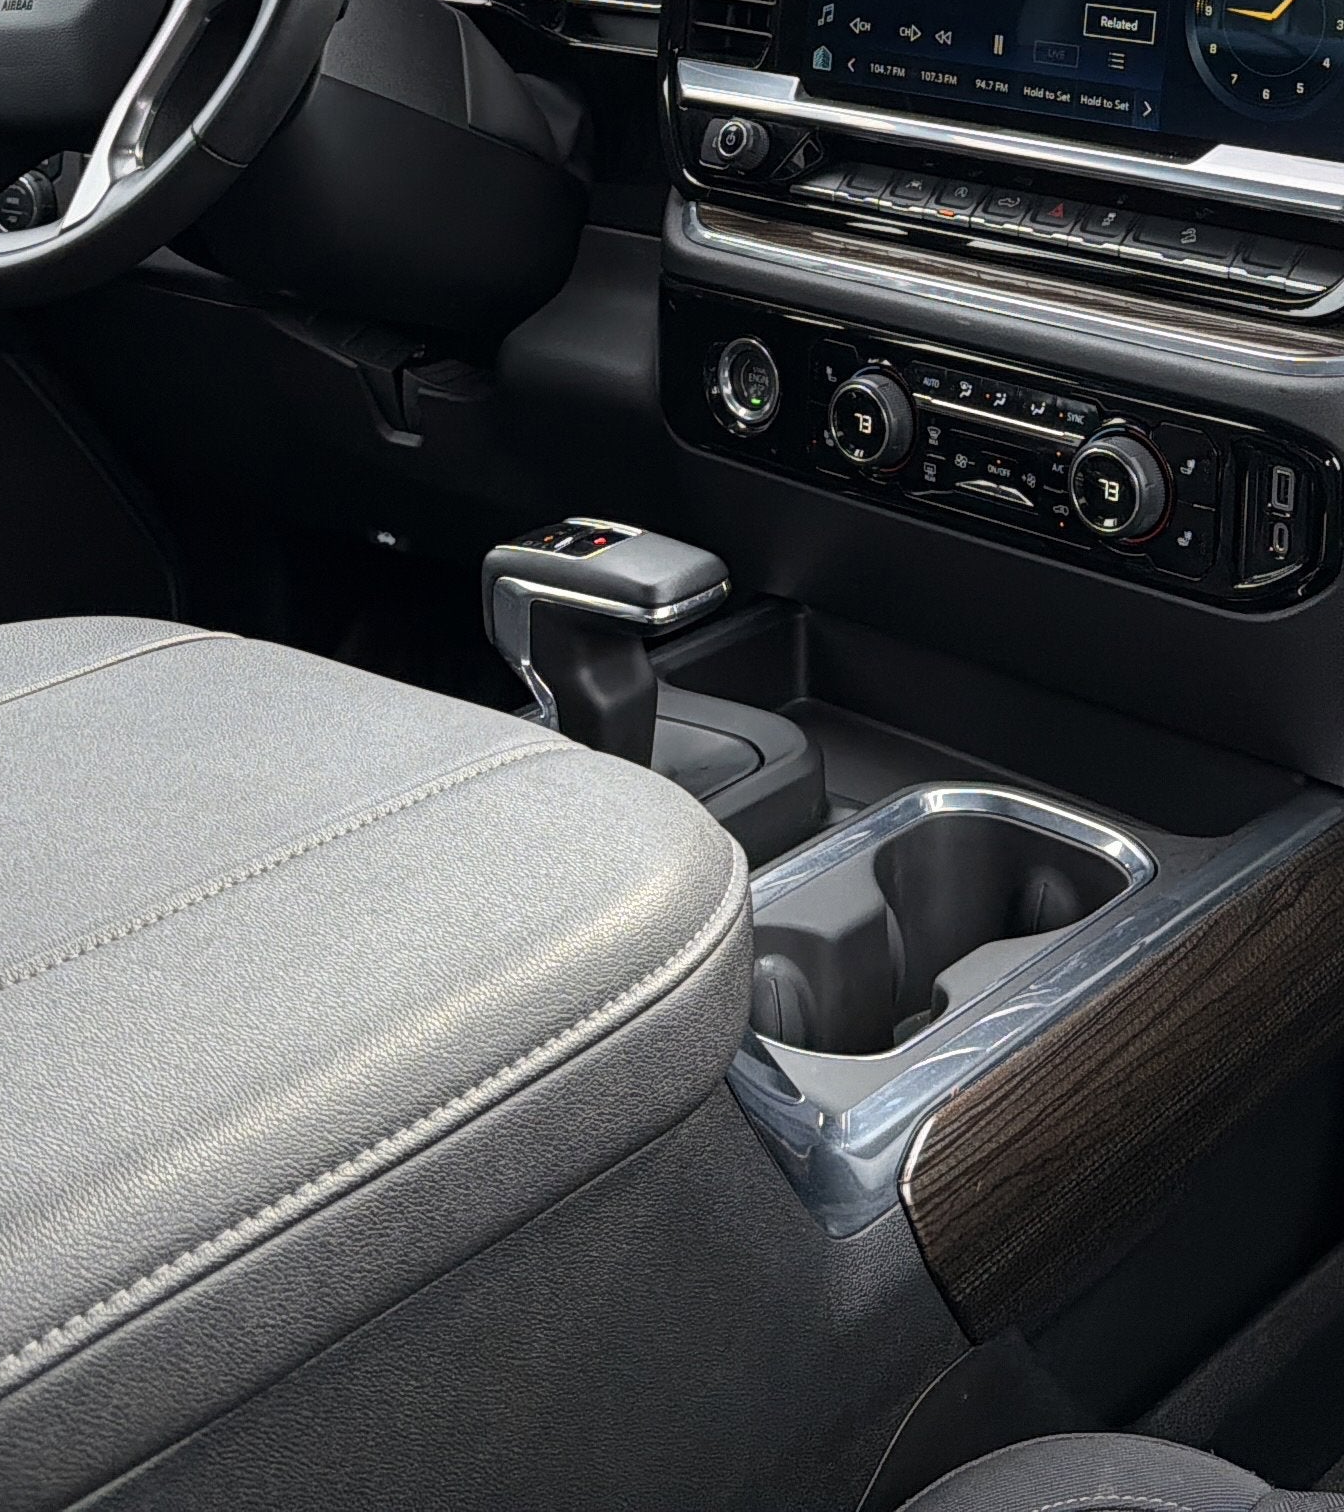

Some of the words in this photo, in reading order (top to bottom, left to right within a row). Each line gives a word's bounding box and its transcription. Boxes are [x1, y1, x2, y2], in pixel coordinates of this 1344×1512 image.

[0, 0, 34, 12] AIRBAG
[1205, 5, 1213, 17] 9
[860, 21, 871, 32] CH
[1100, 15, 1138, 31] Related
[1336, 19, 1344, 31] 3
[899, 26, 911, 37] CH
[1209, 43, 1217, 55] 8
[1322, 57, 1331, 69] 4
[870, 63, 891, 76] 104.7
[892, 66, 906, 78] FM
[920, 70, 943, 84] 107.3
[943, 74, 958, 86] FM
[1231, 73, 1239, 85] 7
[975, 79, 993, 90] 94.7
[994, 82, 1009, 94] FM
[1296, 82, 1305, 95] 5
[1023, 86, 1044, 99] Hold
[1045, 90, 1055, 100] to
[1056, 91, 1071, 104] Set
[1262, 88, 1271, 100] 6
[1080, 94, 1101, 107] Hold
[1103, 98, 1113, 109] to
[1114, 99, 1129, 112] Set
[923, 376, 940, 388] AUTO
[854, 413, 872, 434] 73
[1066, 412, 1085, 426] SYNC
[987, 464, 1011, 479] ON/OFF
[1052, 463, 1065, 475] A/C
[1098, 478, 1119, 502] 73
